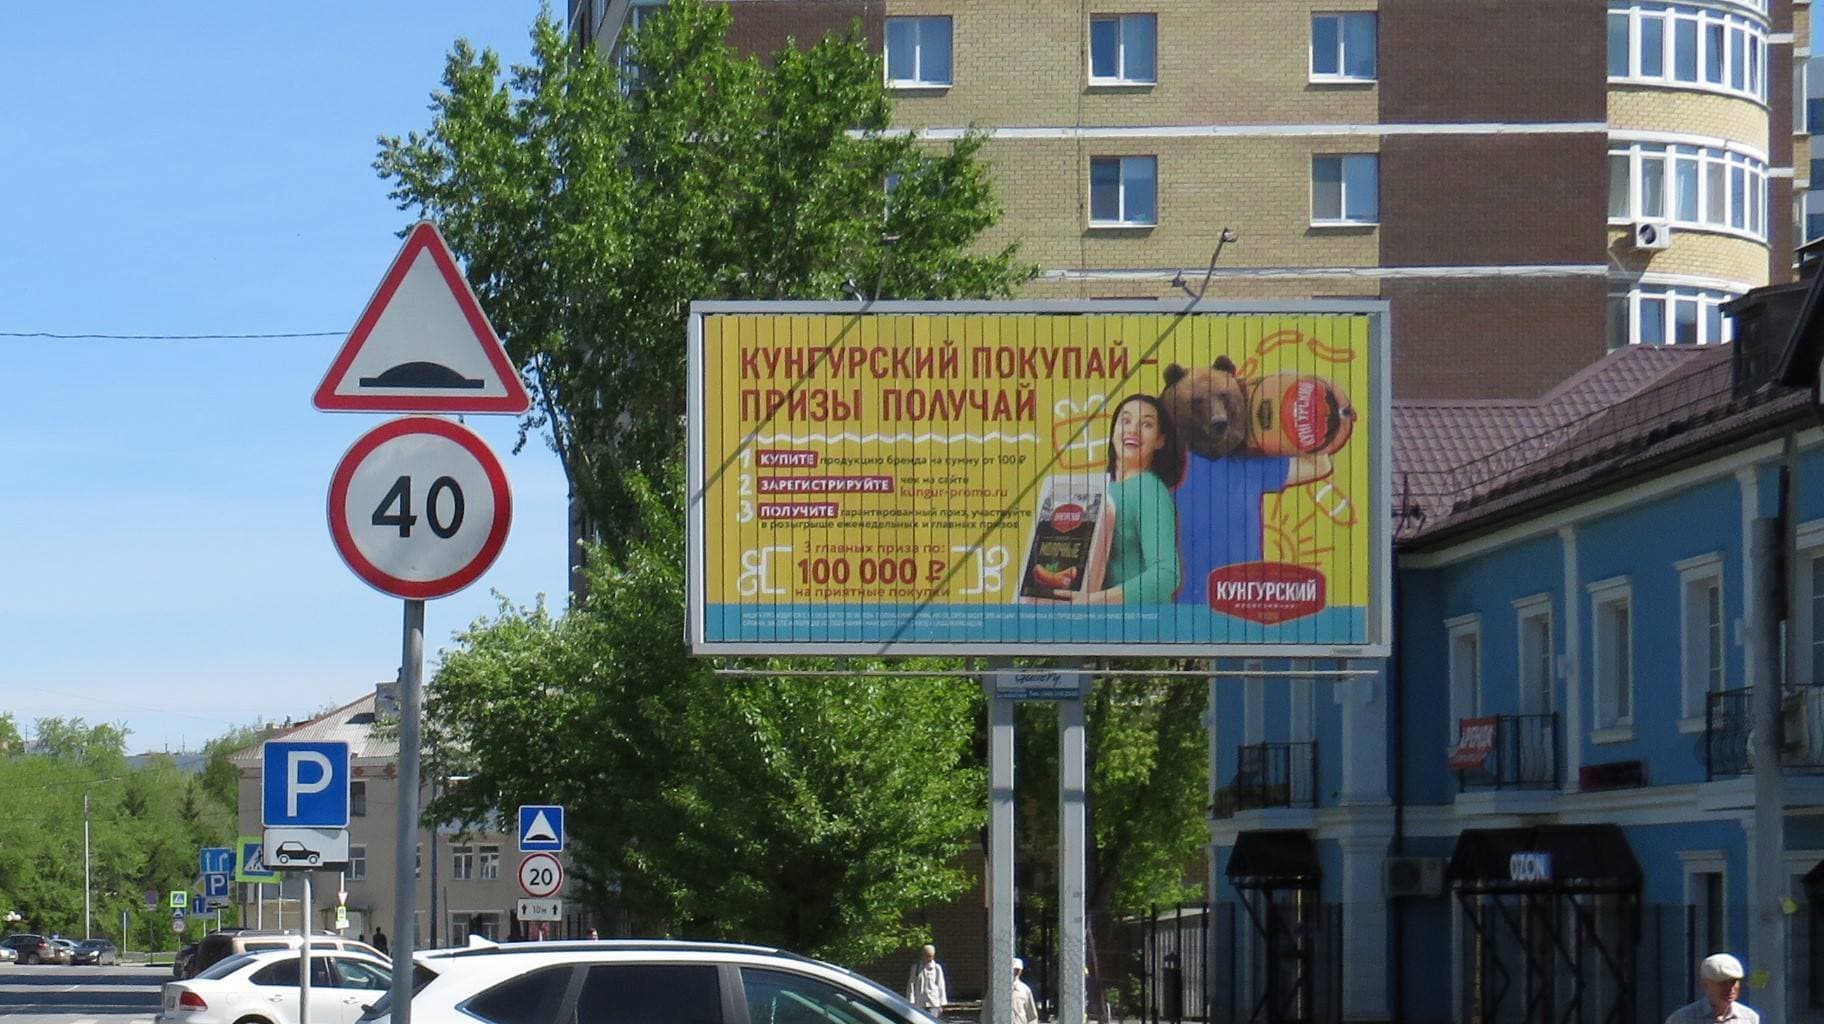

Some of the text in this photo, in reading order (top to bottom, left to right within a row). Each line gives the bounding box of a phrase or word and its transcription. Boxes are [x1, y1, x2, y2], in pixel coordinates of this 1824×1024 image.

[741, 340, 959, 379] КУНГУРСКИЙ
[973, 340, 1128, 379] ПОКУПАЙ
[741, 383, 1036, 421] ПРИЗЫ ПОЛУЧАЙ
[760, 454, 814, 465] КУПИТЕ
[820, 457, 883, 466] продукцию
[886, 455, 926, 466] бренда
[945, 457, 978, 466] сумму
[761, 477, 889, 491] ЗАРЕГИСТРИРУЙТЕ
[938, 475, 969, 484] сайте
[899, 487, 1008, 500] kungur-promo.ru
[372, 475, 465, 539] 40
[761, 505, 834, 517] ПОЛУЧИТЕ
[841, 508, 937, 517] гарантированный
[971, 508, 1032, 518] участвуйте
[770, 521, 834, 530] розыгрыше
[837, 521, 918, 529] еженедельных
[804, 541, 945, 554] 3 главных приза по:
[797, 558, 850, 584] 100
[859, 558, 917, 584] 000
[796, 588, 950, 598] на приятные покупки
[1217, 578, 1316, 601] КУНГУРСКИЙ
[287, 751, 333, 817] P
[211, 875, 225, 895] P
[529, 868, 553, 886] 20
